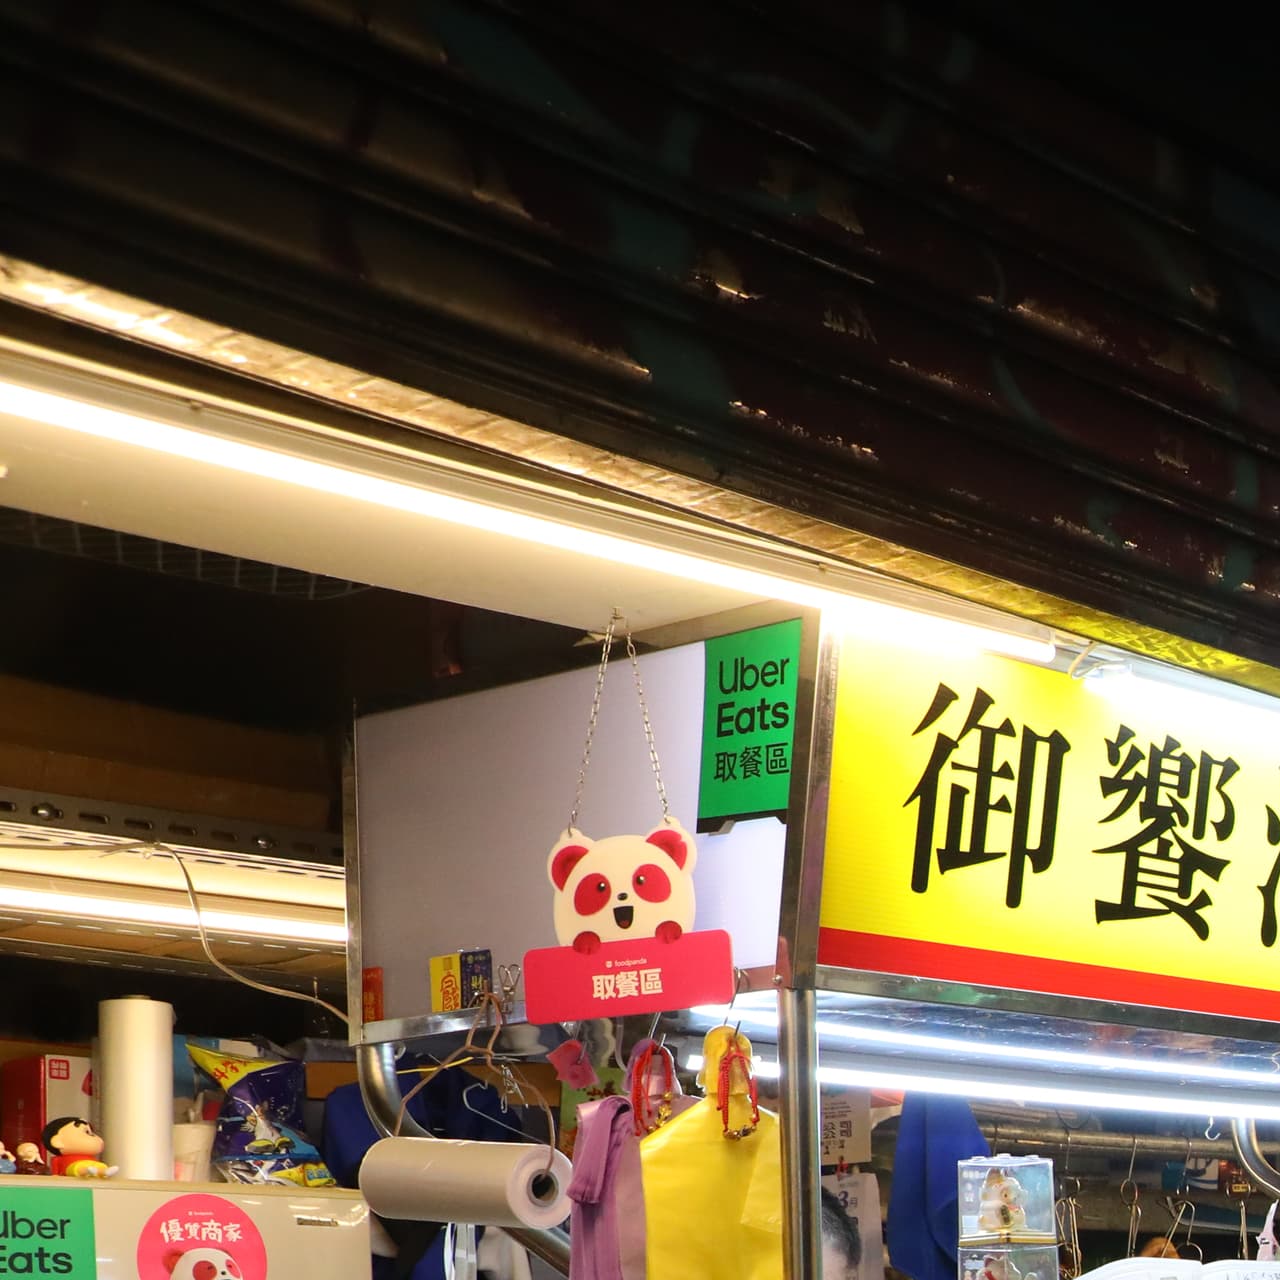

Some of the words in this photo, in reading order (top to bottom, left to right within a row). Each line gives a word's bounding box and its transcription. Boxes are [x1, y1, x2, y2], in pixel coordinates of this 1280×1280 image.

[718, 657, 790, 694] Uber
[716, 698, 790, 738] Eats
[713, 742, 790, 783] 取餐區
[614, 957, 648, 968] foodpanda
[592, 967, 663, 1000] 取餐區
[160, 1218, 243, 1244] 優質商家
